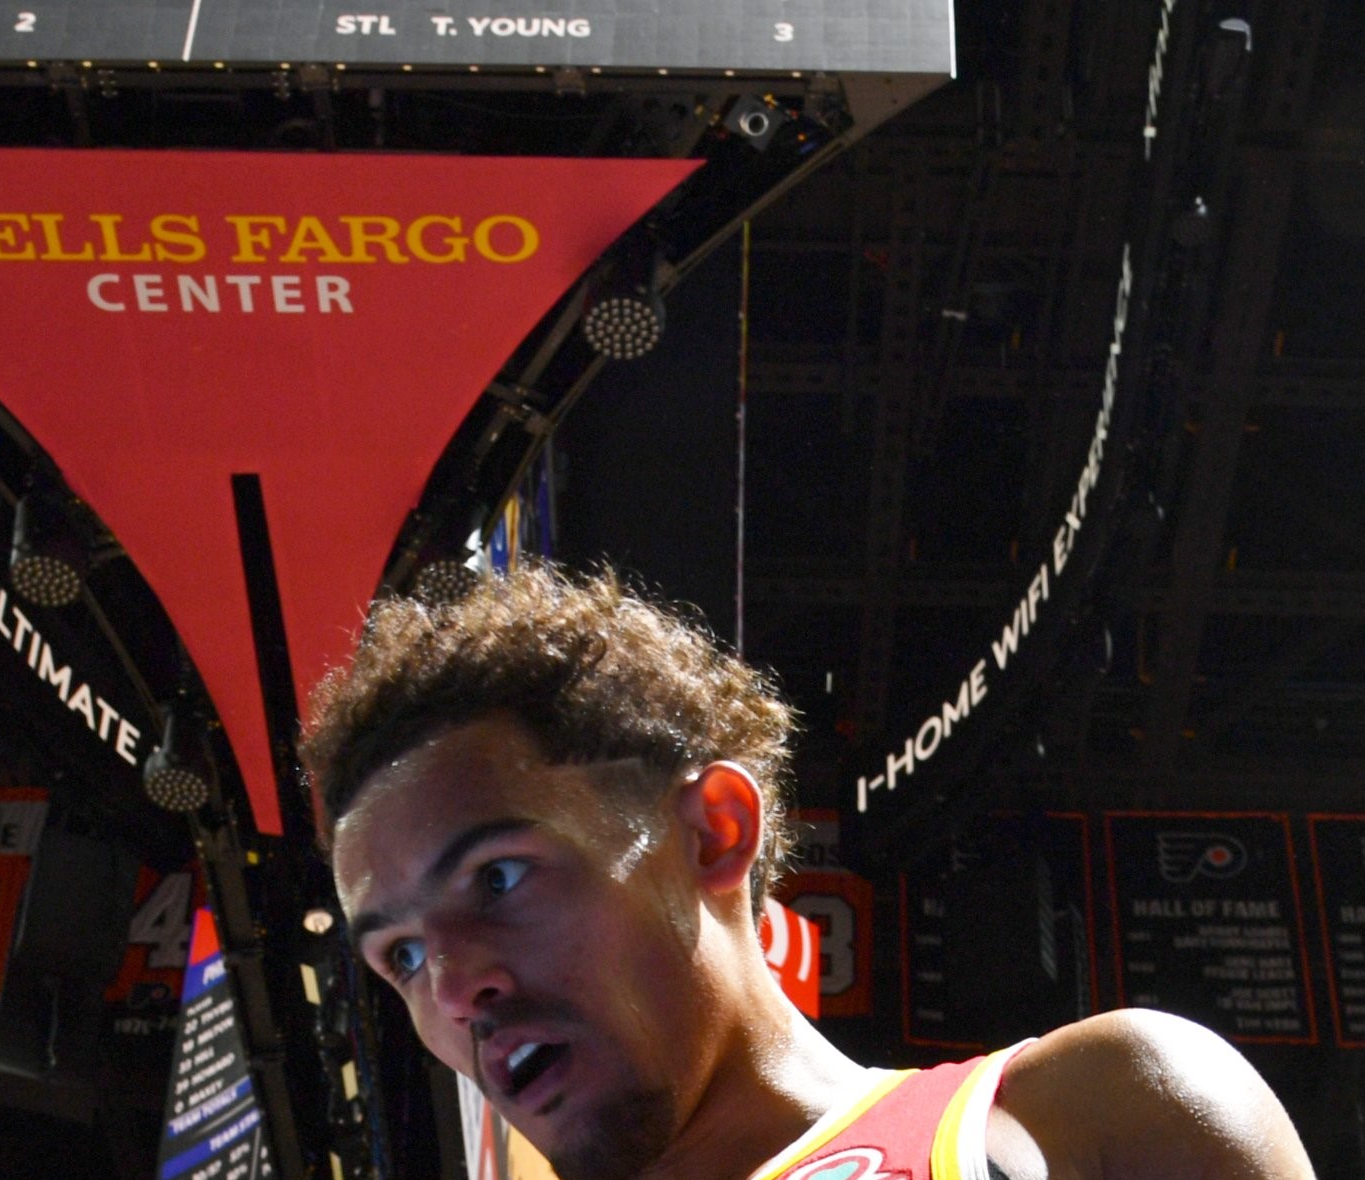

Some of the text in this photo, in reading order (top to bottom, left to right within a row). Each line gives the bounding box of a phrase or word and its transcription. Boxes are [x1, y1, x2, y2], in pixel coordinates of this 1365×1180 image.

[13, 11, 36, 33] 2
[336, 14, 795, 43] STL T. YOUNG 3
[227, 213, 539, 265] FARGO
[87, 273, 354, 314] CENTER
[991, 562, 1050, 672] WIFI
[128, 871, 193, 969] 4
[1131, 898, 1283, 920] HALL OF FAME
